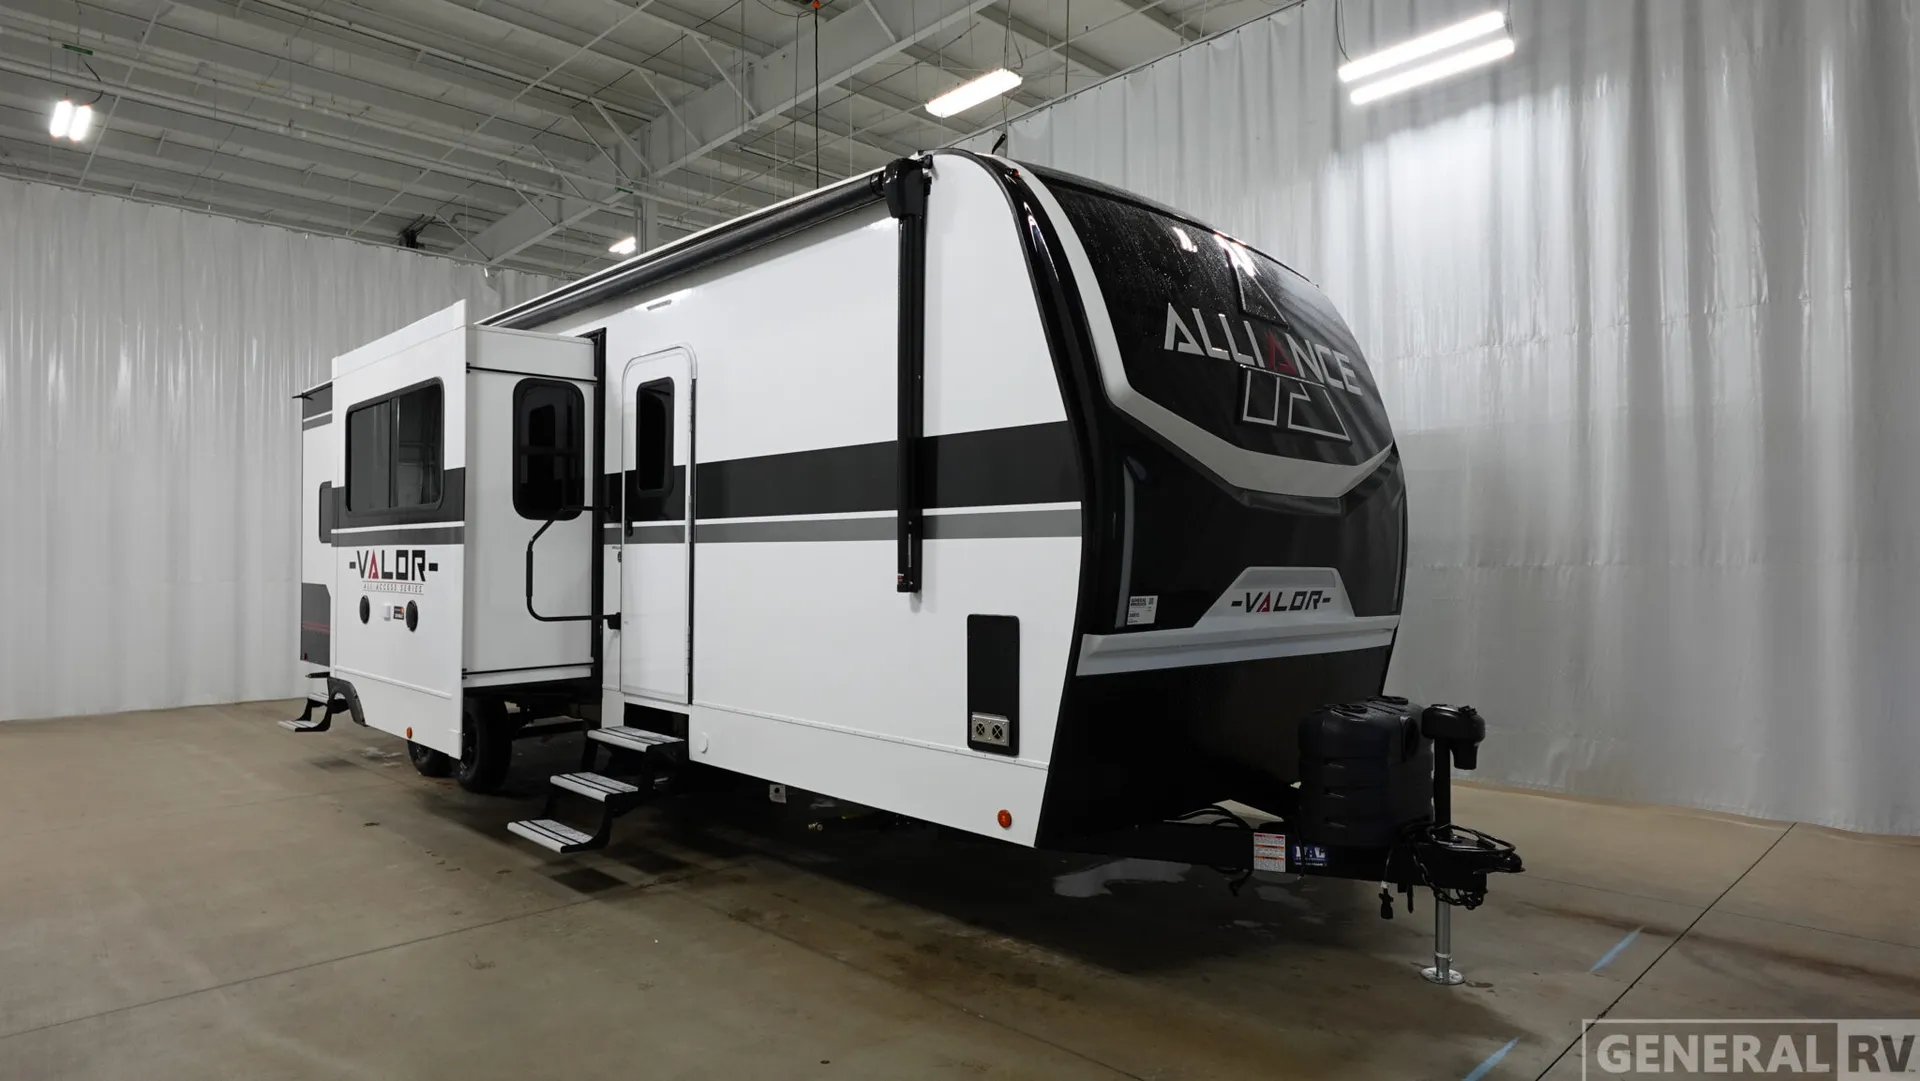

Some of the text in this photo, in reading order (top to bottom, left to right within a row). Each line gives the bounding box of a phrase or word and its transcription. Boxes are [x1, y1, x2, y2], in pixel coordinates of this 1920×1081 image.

[1164, 302, 1363, 396] ALLIANCE
[376, 583, 397, 591] ACCESS
[400, 584, 422, 593] SERIES
